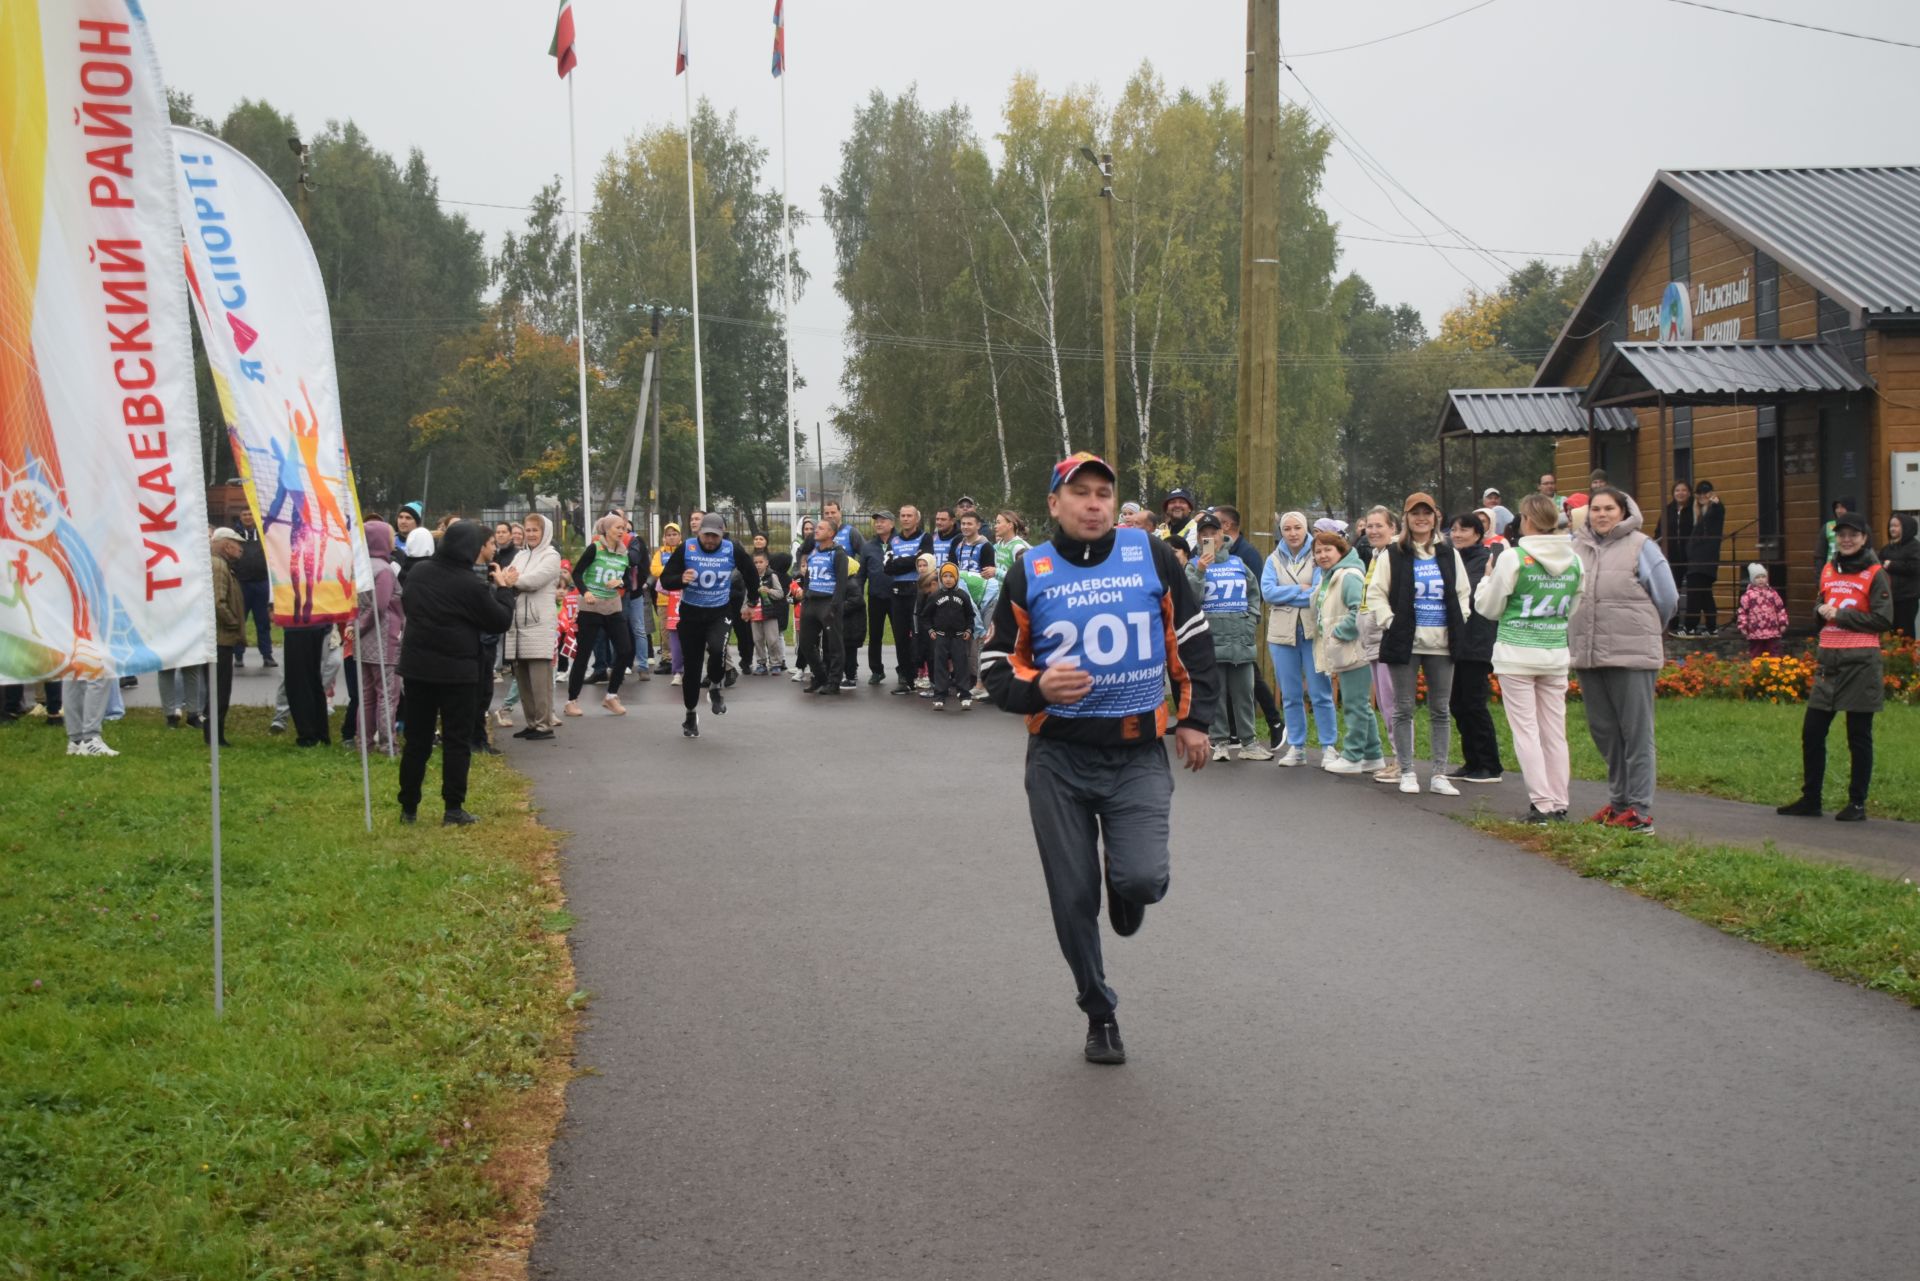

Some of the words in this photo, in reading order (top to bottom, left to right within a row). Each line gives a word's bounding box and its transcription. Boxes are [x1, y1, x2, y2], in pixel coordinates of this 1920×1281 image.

[75, 19, 135, 208] РАЙОН
[180, 154, 248, 309] СПОРТ!
[1695, 267, 1749, 315] Лыжный
[240, 358, 265, 384] Я
[89, 240, 182, 601] ТУКАЕВСКИЙ
[1044, 573, 1143, 599] ТУКАЕВСКИЙ
[1067, 590, 1123, 609] РАЙОН
[1204, 579, 1247, 600] 277
[1042, 611, 1152, 667] 201
